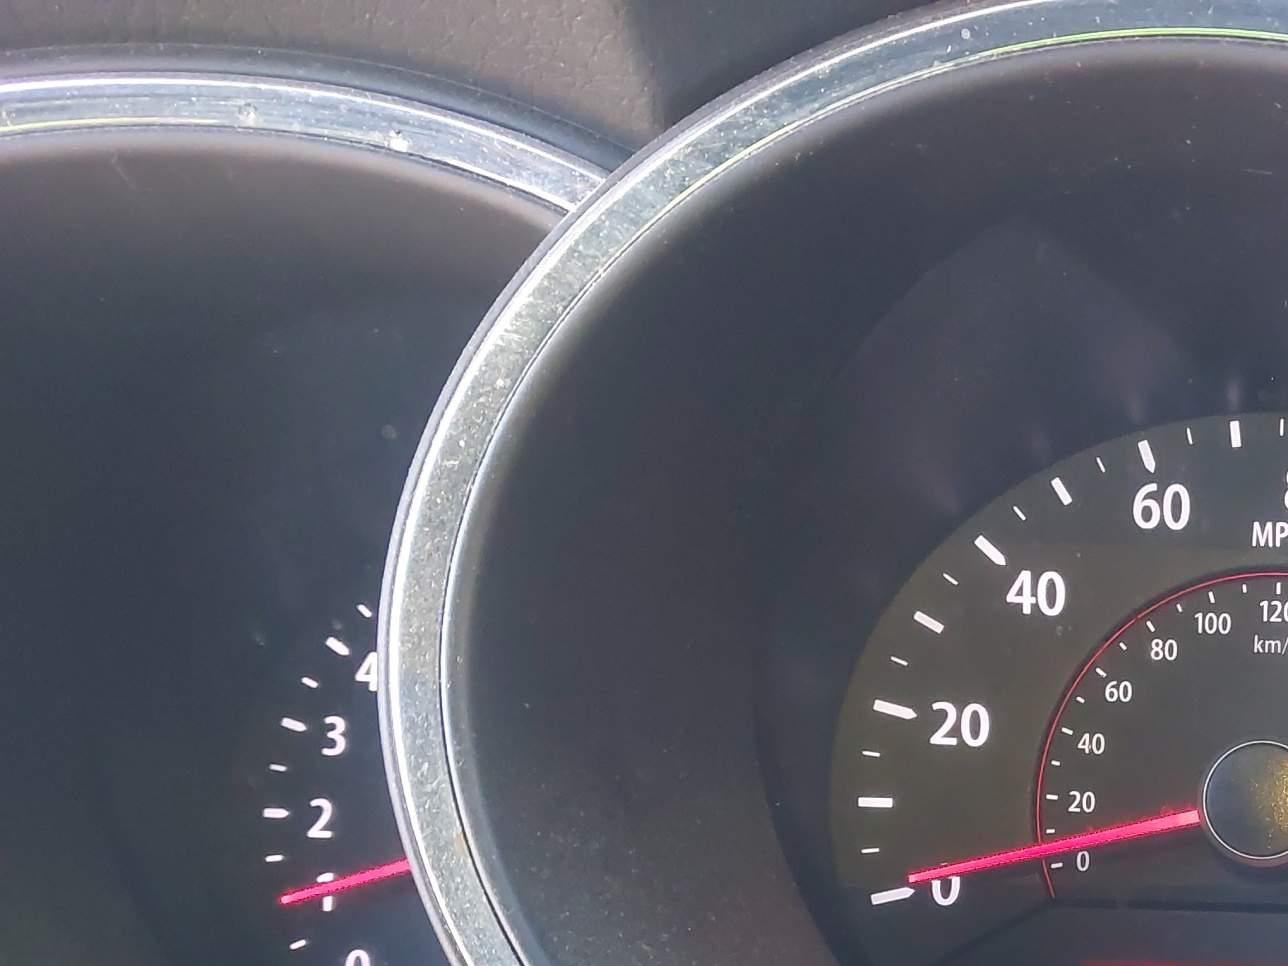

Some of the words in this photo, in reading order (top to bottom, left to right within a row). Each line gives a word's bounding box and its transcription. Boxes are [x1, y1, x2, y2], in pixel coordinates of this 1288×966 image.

[1132, 483, 1190, 530] 60
[1006, 570, 1066, 616] 40
[1194, 613, 1231, 634] 100
[1150, 639, 1178, 661] 80
[1105, 681, 1132, 702] 60
[929, 702, 990, 747] 20
[322, 716, 346, 756] 3
[1077, 733, 1105, 755] 40
[1068, 791, 1095, 812] 20
[307, 799, 333, 839] 2
[1076, 851, 1090, 871] 0
